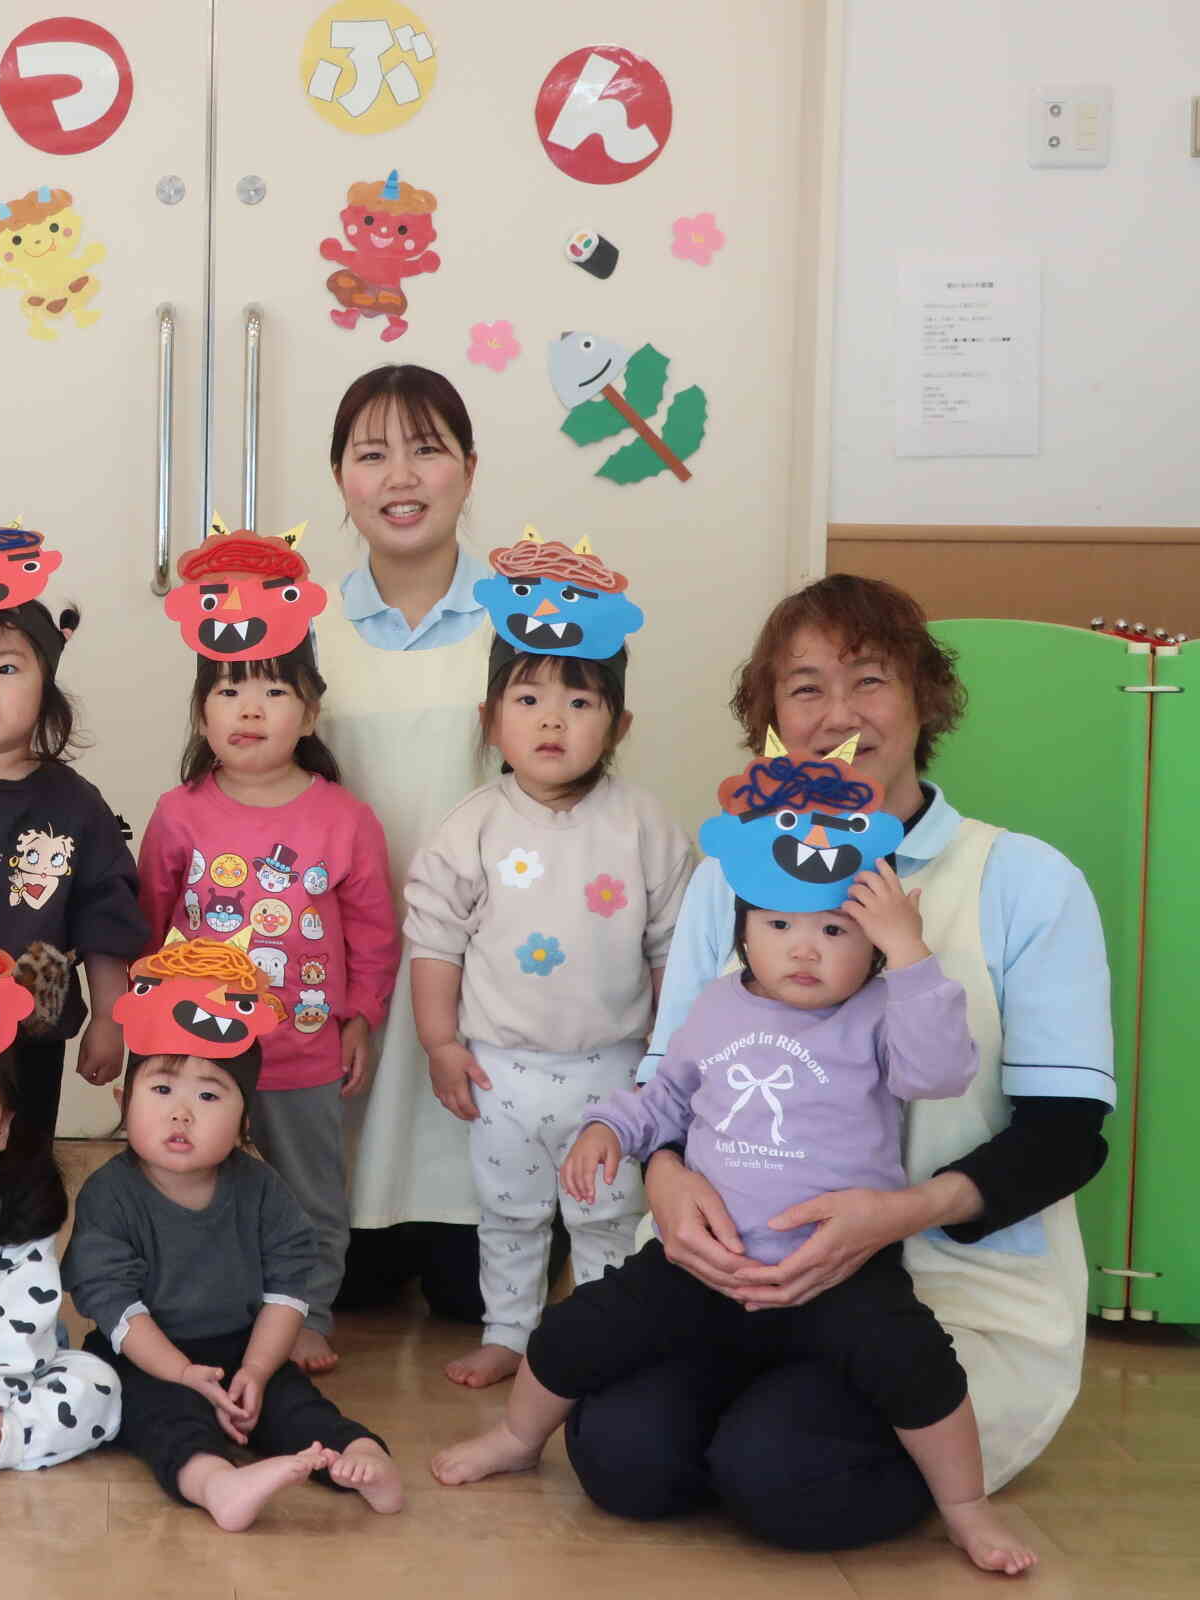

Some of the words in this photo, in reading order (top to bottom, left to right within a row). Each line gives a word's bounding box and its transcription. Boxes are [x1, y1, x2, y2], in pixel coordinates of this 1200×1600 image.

[758, 1031, 773, 1045] In
[775, 1034, 830, 1085] Ribbons
[737, 1140, 806, 1159] Dreams
